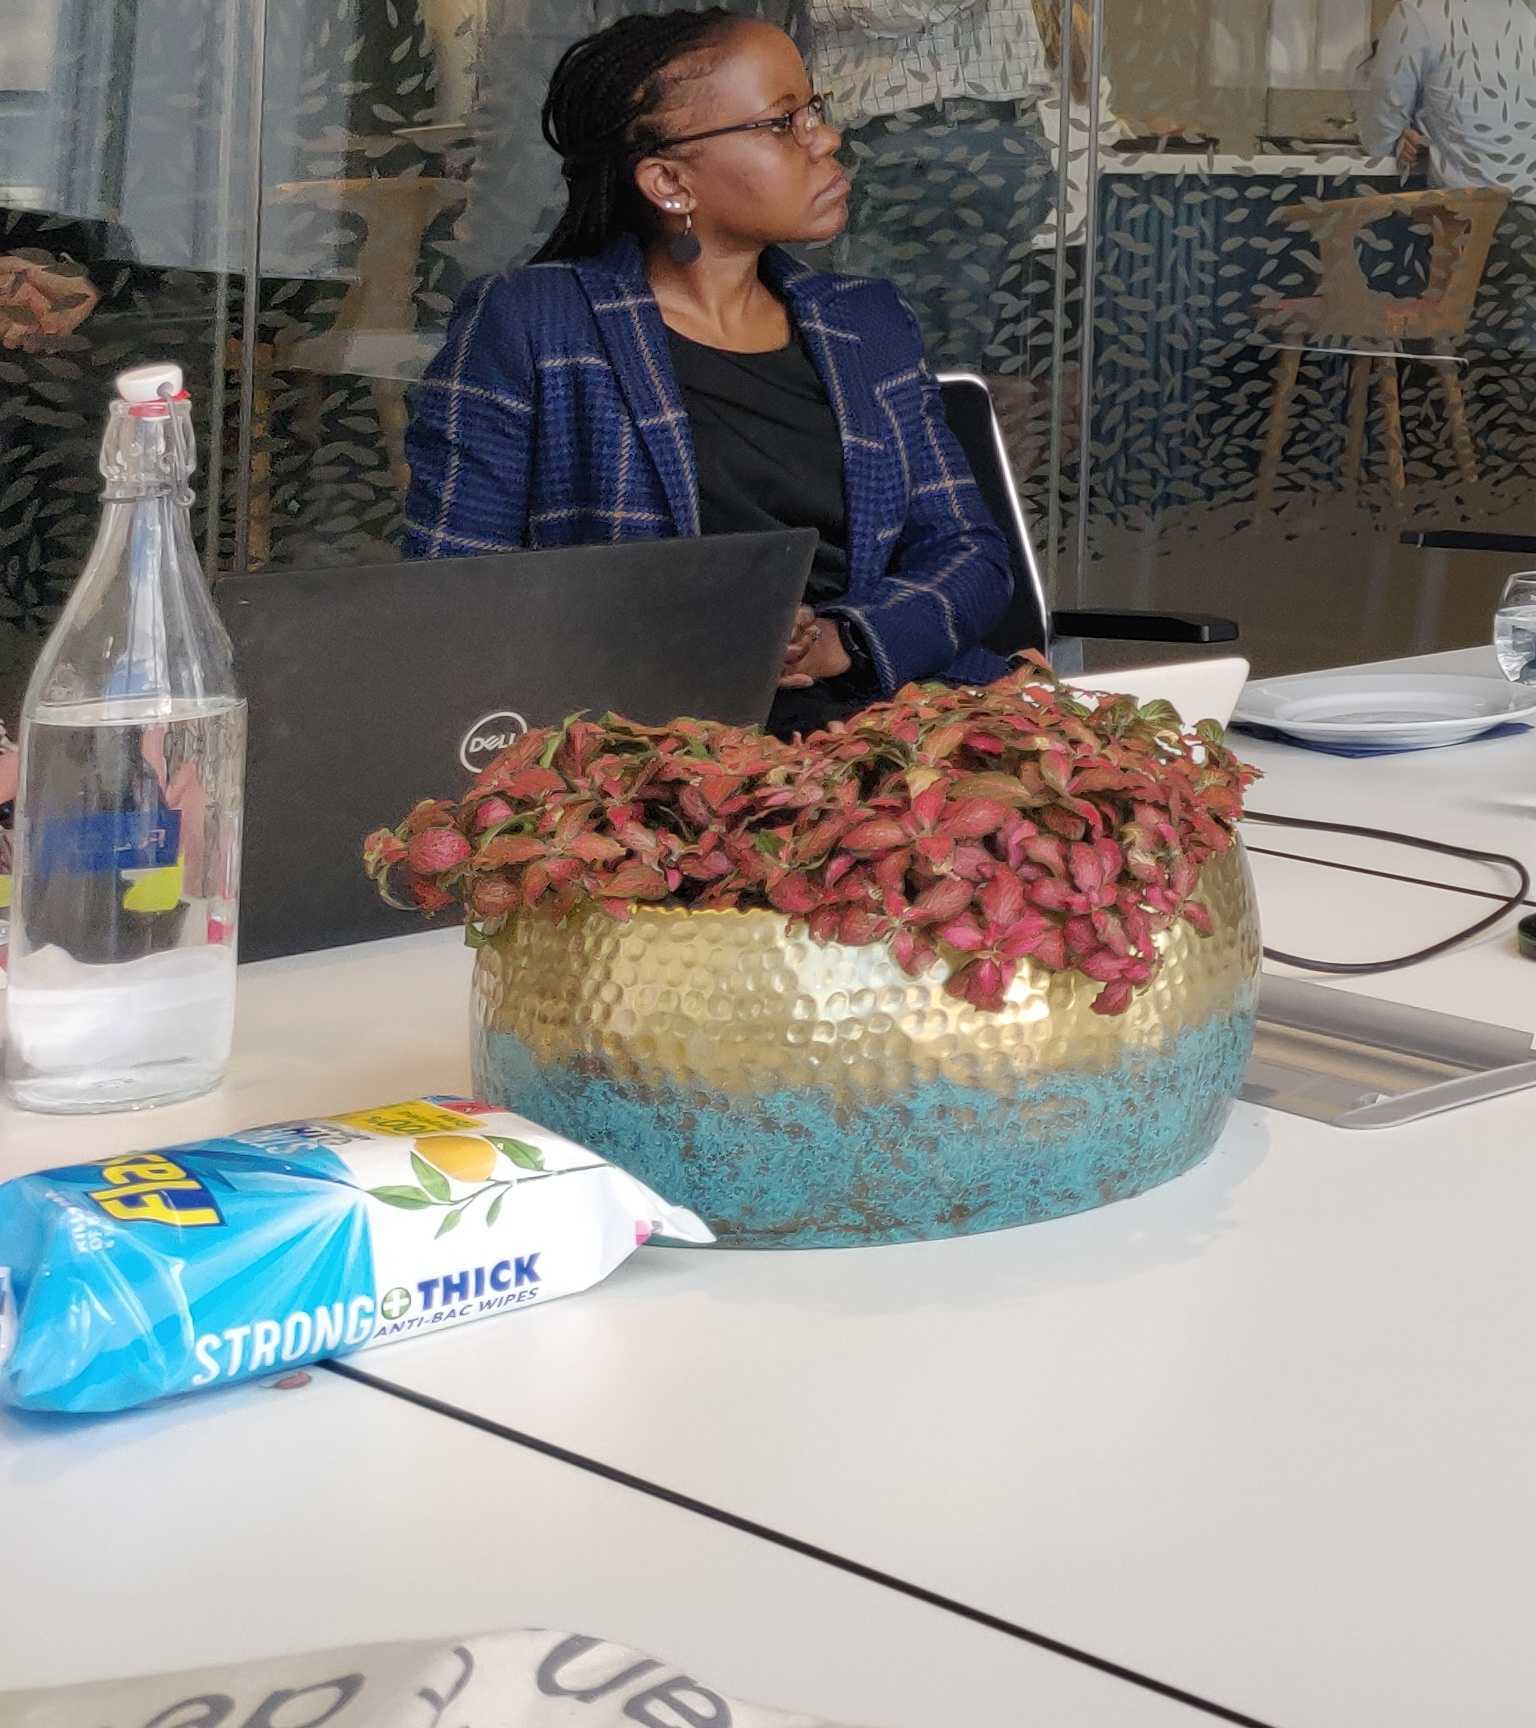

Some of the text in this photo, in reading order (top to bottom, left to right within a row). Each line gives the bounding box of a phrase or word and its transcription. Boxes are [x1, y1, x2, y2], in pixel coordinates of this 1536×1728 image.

[191, 1251, 543, 1386] STRONG THICK
[372, 1286, 540, 1340] ANTI-BAC WIPES
